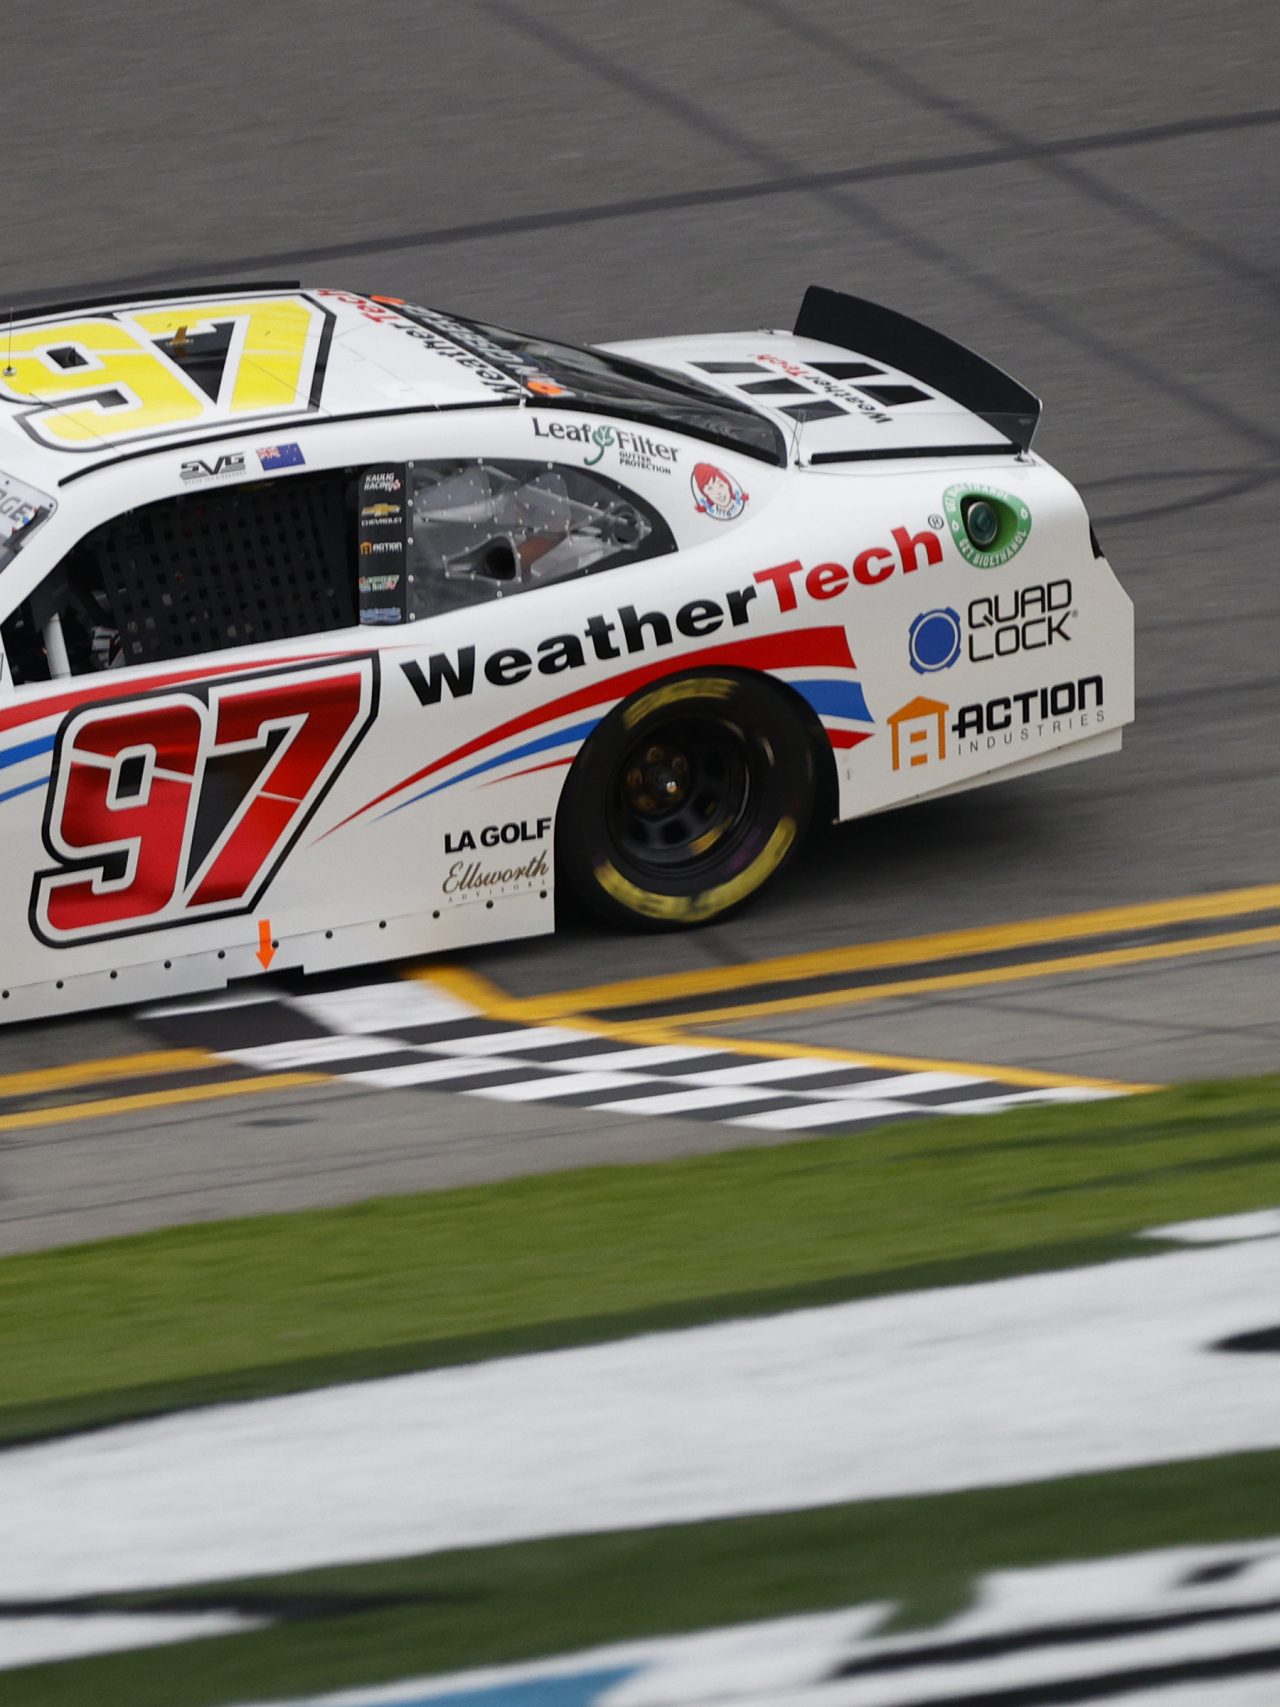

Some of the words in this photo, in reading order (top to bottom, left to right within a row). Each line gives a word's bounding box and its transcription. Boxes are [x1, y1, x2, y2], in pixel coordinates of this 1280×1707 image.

[180, 452, 246, 480] SVG
[365, 473, 395, 483] KAULIG
[619, 457, 671, 475] PROTECTION
[399, 525, 945, 706] WeatherTech
[967, 578, 1073, 629] QUAD
[968, 610, 1072, 663] LOCK
[951, 674, 1104, 739] ACTION
[957, 709, 1105, 756] INDUSTRIES
[28, 650, 381, 949] 97
[444, 829, 477, 854] LA
[480, 816, 552, 847] GOLF
[442, 849, 549, 894] Ellsworth
